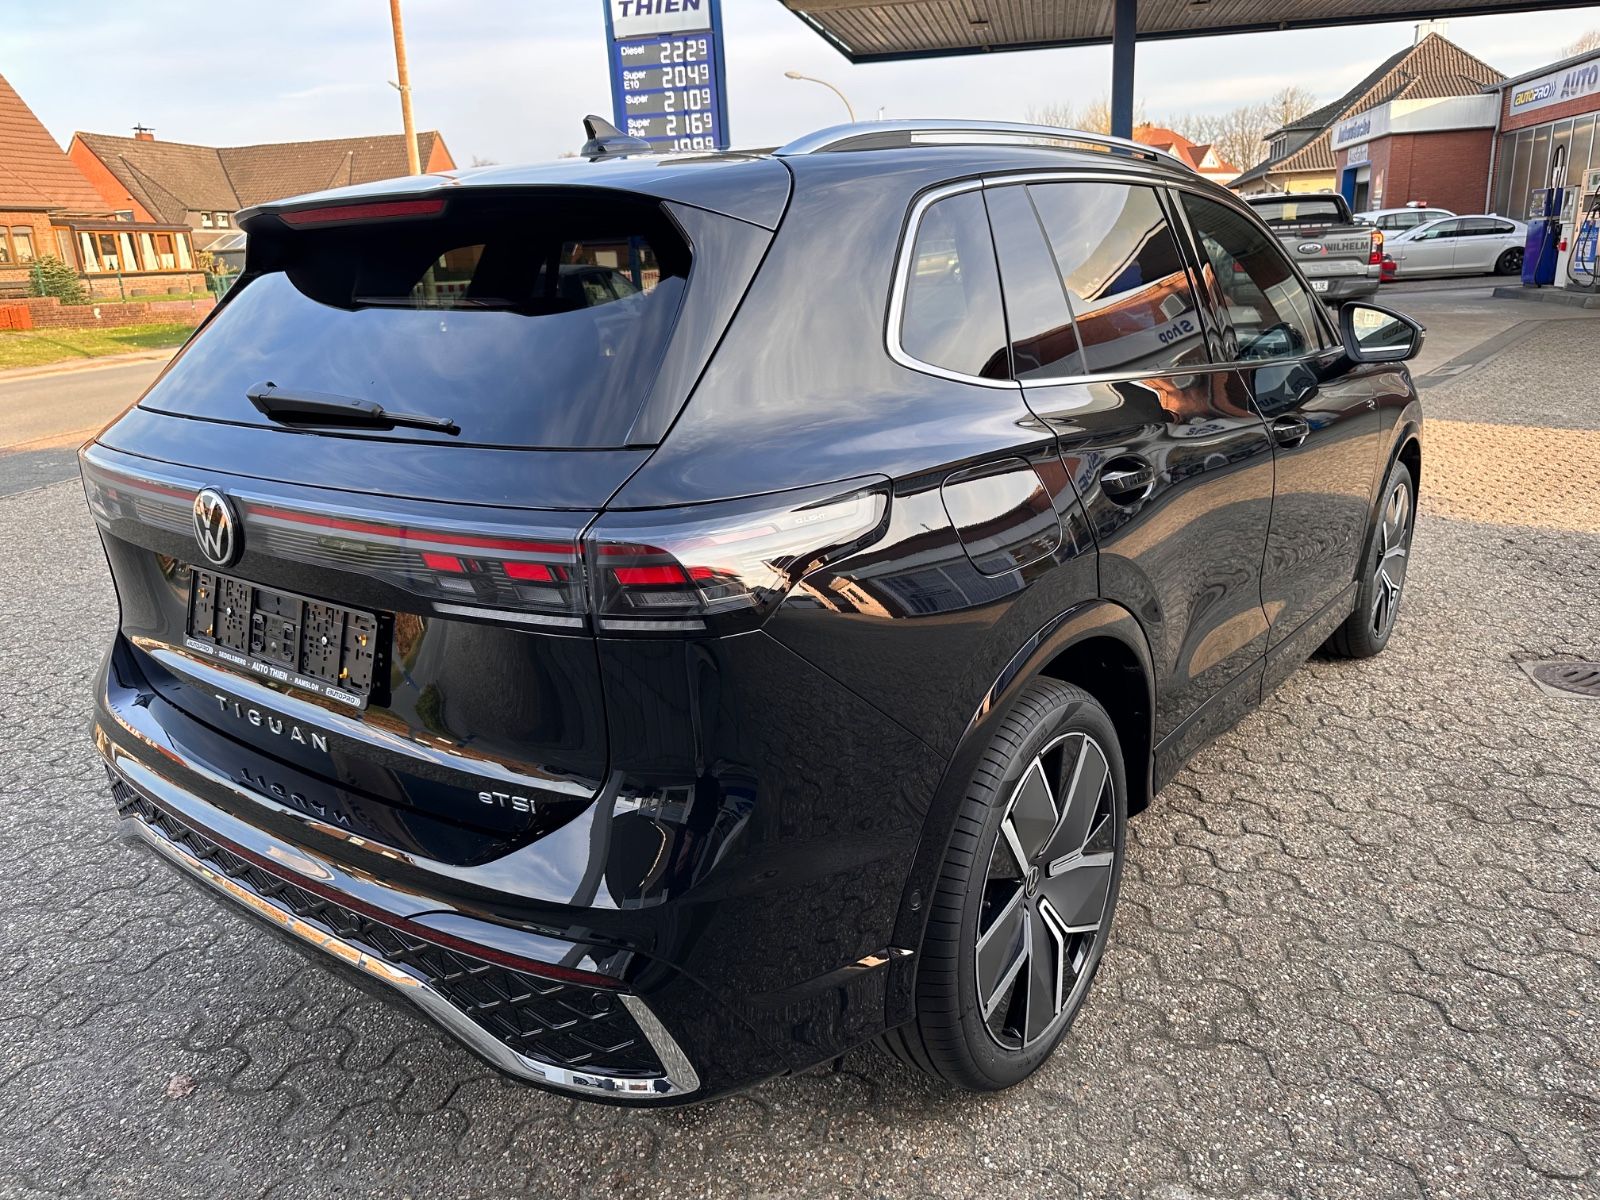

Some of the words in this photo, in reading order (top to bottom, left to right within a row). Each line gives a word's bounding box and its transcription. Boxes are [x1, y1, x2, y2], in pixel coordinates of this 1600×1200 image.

[618, 0, 702, 17] THIEN
[620, 45, 645, 56] Diesel
[660, 39, 707, 64] 2229
[623, 70, 647, 81] Super
[662, 64, 709, 88] 2049
[623, 80, 640, 90] E10
[1560, 64, 1599, 99] AUTO
[625, 94, 648, 105] Super
[627, 118, 650, 128] Super
[628, 128, 646, 137] Plus
[1324, 241, 1369, 252] WILHELM
[251, 661, 269, 674] AUTO
[269, 667, 288, 681] THIEN
[215, 694, 328, 753] TIGUAN
[478, 791, 537, 814] eTSI
